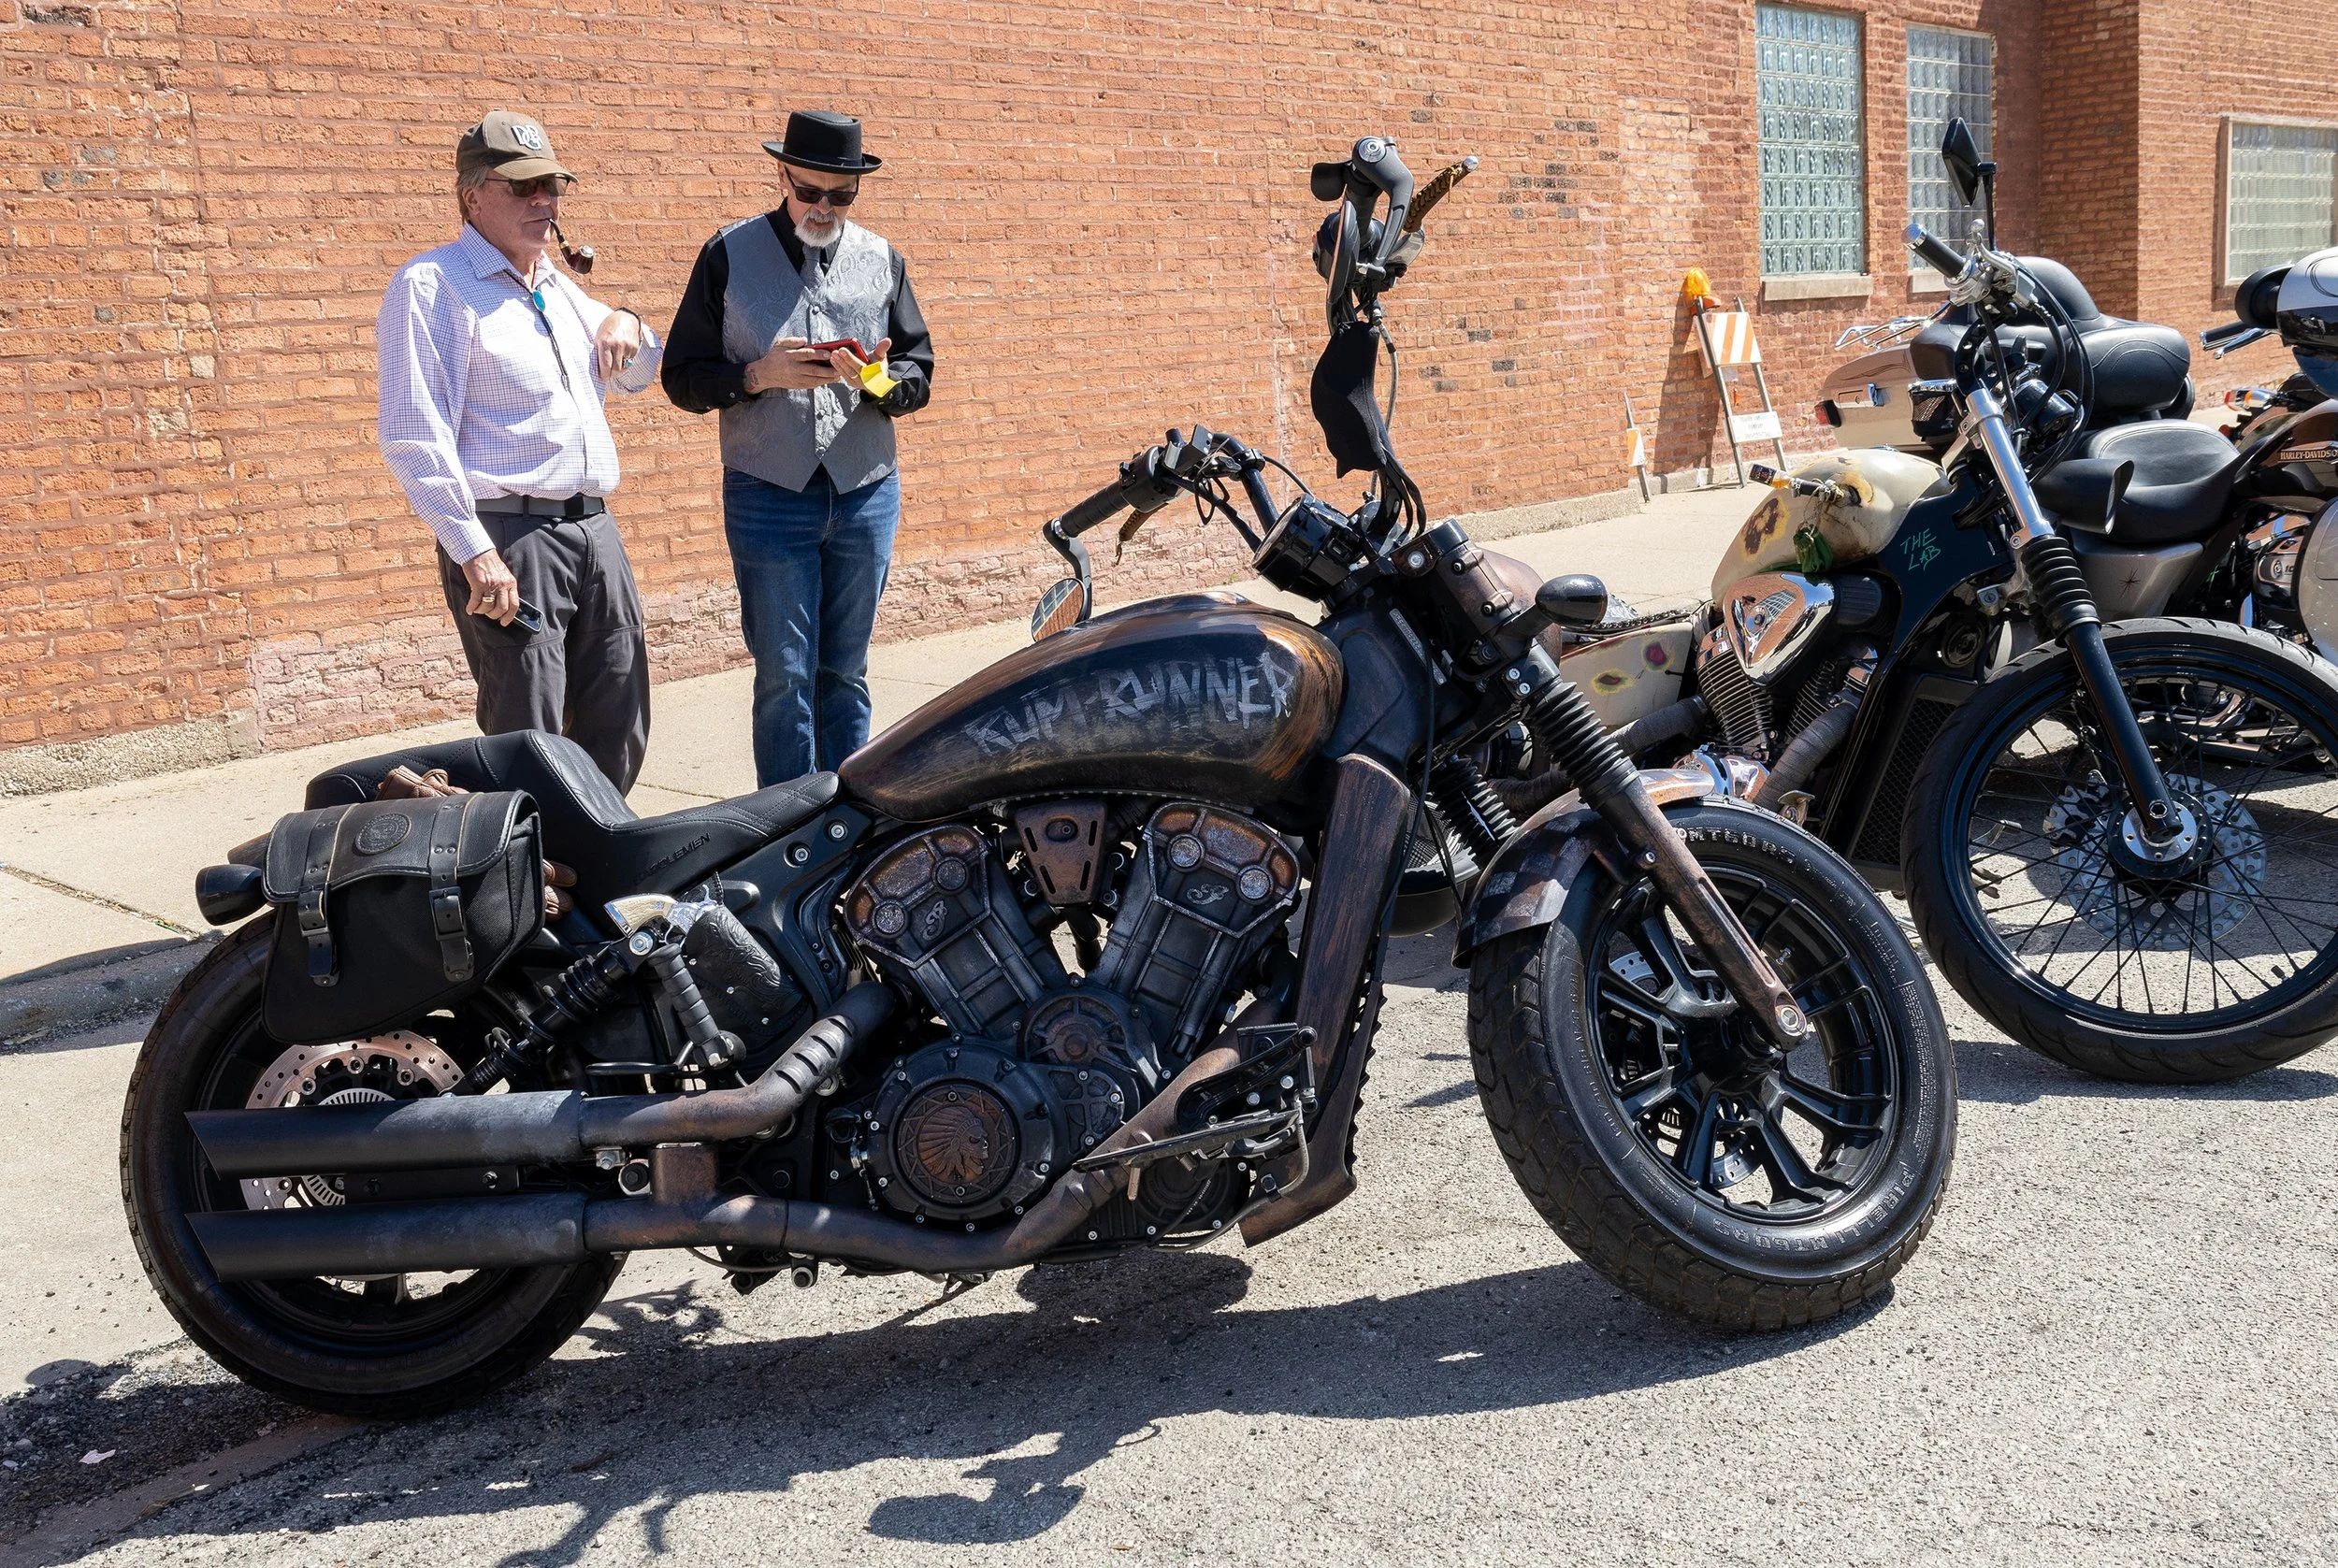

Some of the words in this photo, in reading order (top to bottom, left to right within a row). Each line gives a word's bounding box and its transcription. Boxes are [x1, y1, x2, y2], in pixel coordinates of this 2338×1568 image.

[1899, 528, 1937, 554] THE
[1908, 545, 1941, 571] LAB
[1836, 1167, 1915, 1244] PIRELLI
